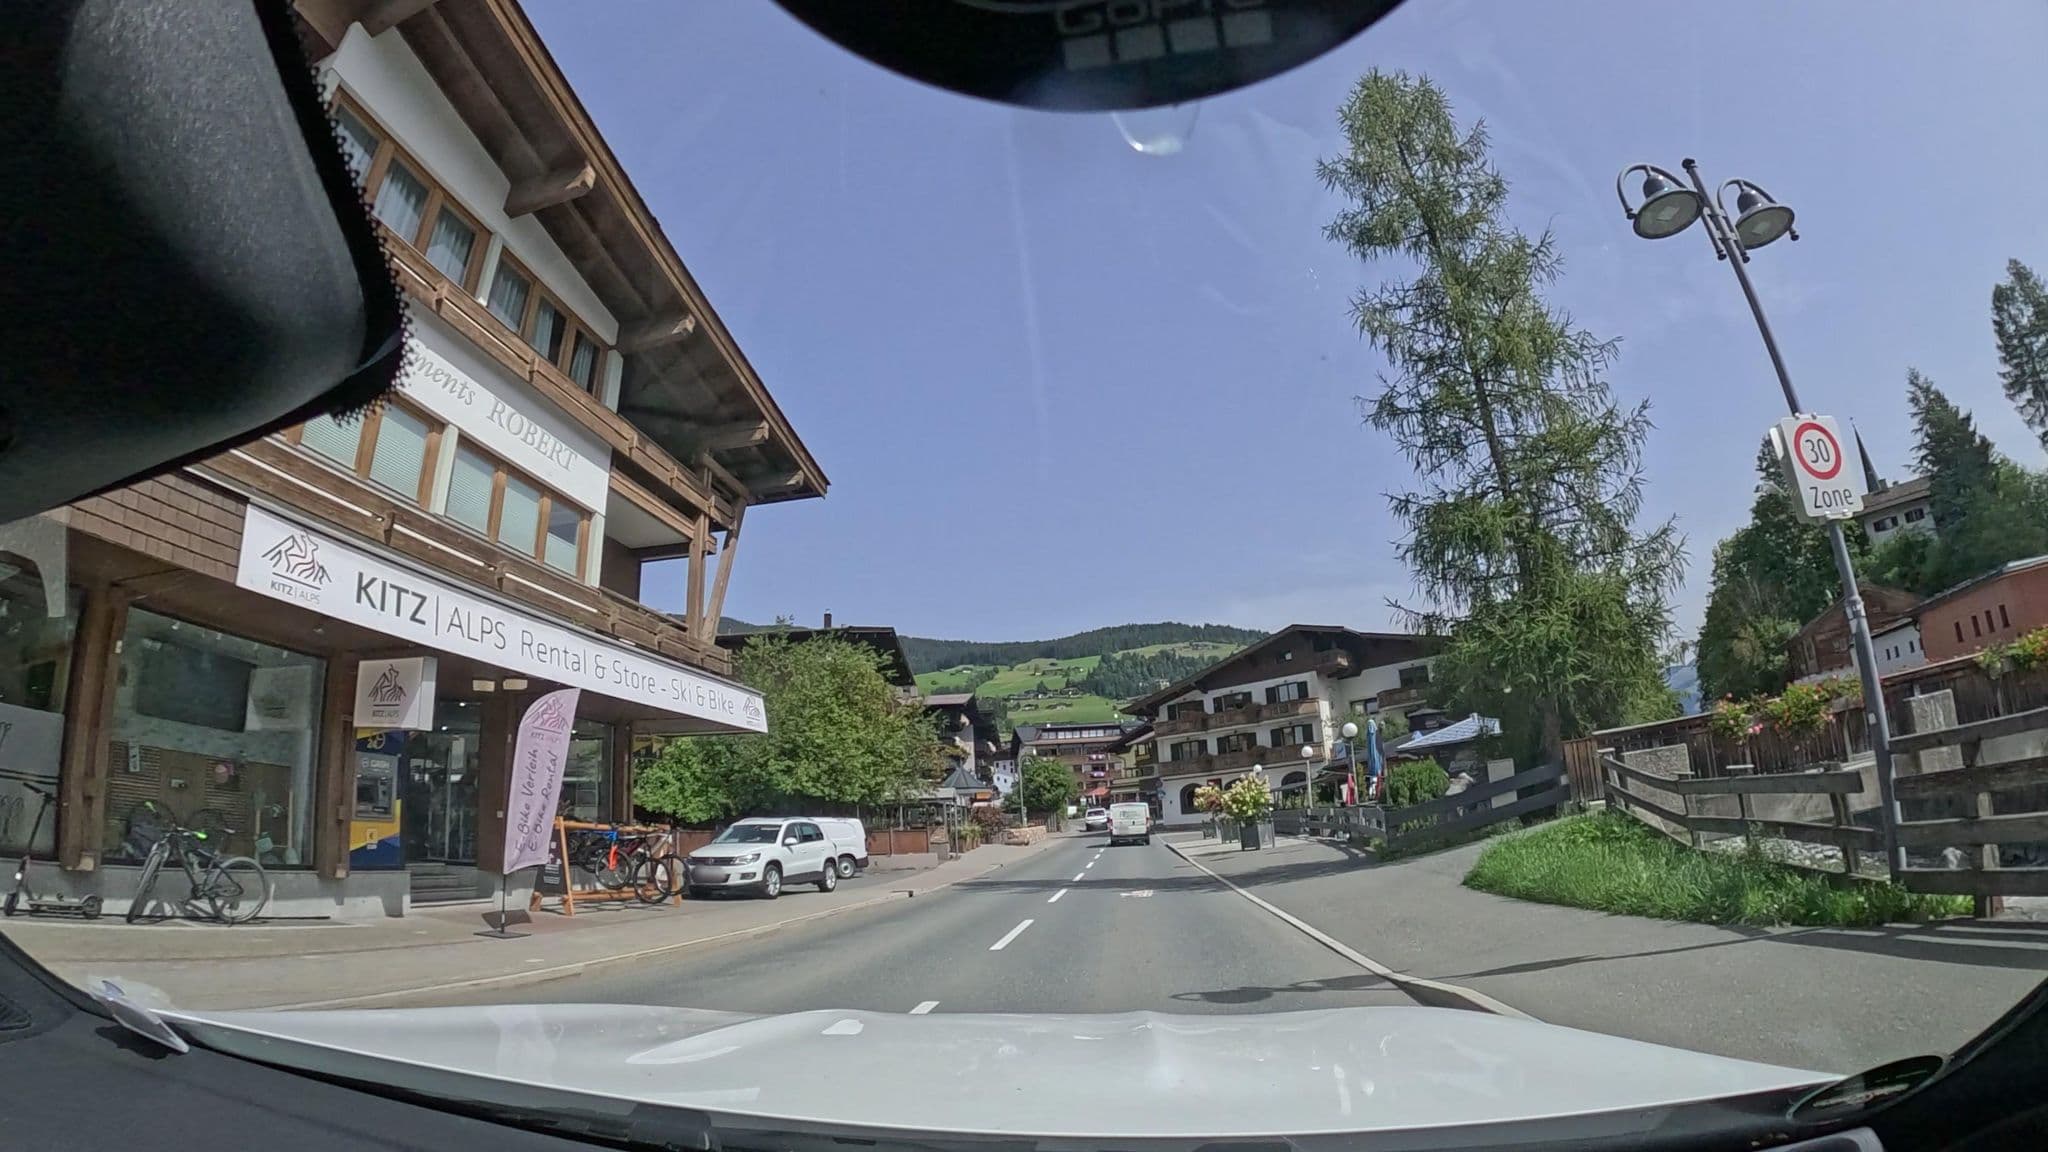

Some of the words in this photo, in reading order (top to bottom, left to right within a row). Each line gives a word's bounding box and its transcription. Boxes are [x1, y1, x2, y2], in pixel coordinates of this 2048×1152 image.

[486, 397, 578, 471] ROBERT
[1804, 438, 1831, 464] 30
[1809, 486, 1854, 509] Zone
[272, 579, 294, 596] KITZ
[299, 591, 321, 606] ALPS
[355, 571, 428, 625] KITZ
[446, 606, 507, 650] ALPS
[521, 630, 588, 675] Rental
[594, 655, 607, 680] &
[612, 660, 657, 694] Store
[670, 678, 693, 703] Ski
[696, 687, 706, 708] &
[708, 689, 735, 715] Bike
[521, 748, 539, 797] Verleih
[541, 751, 558, 801] Rental
